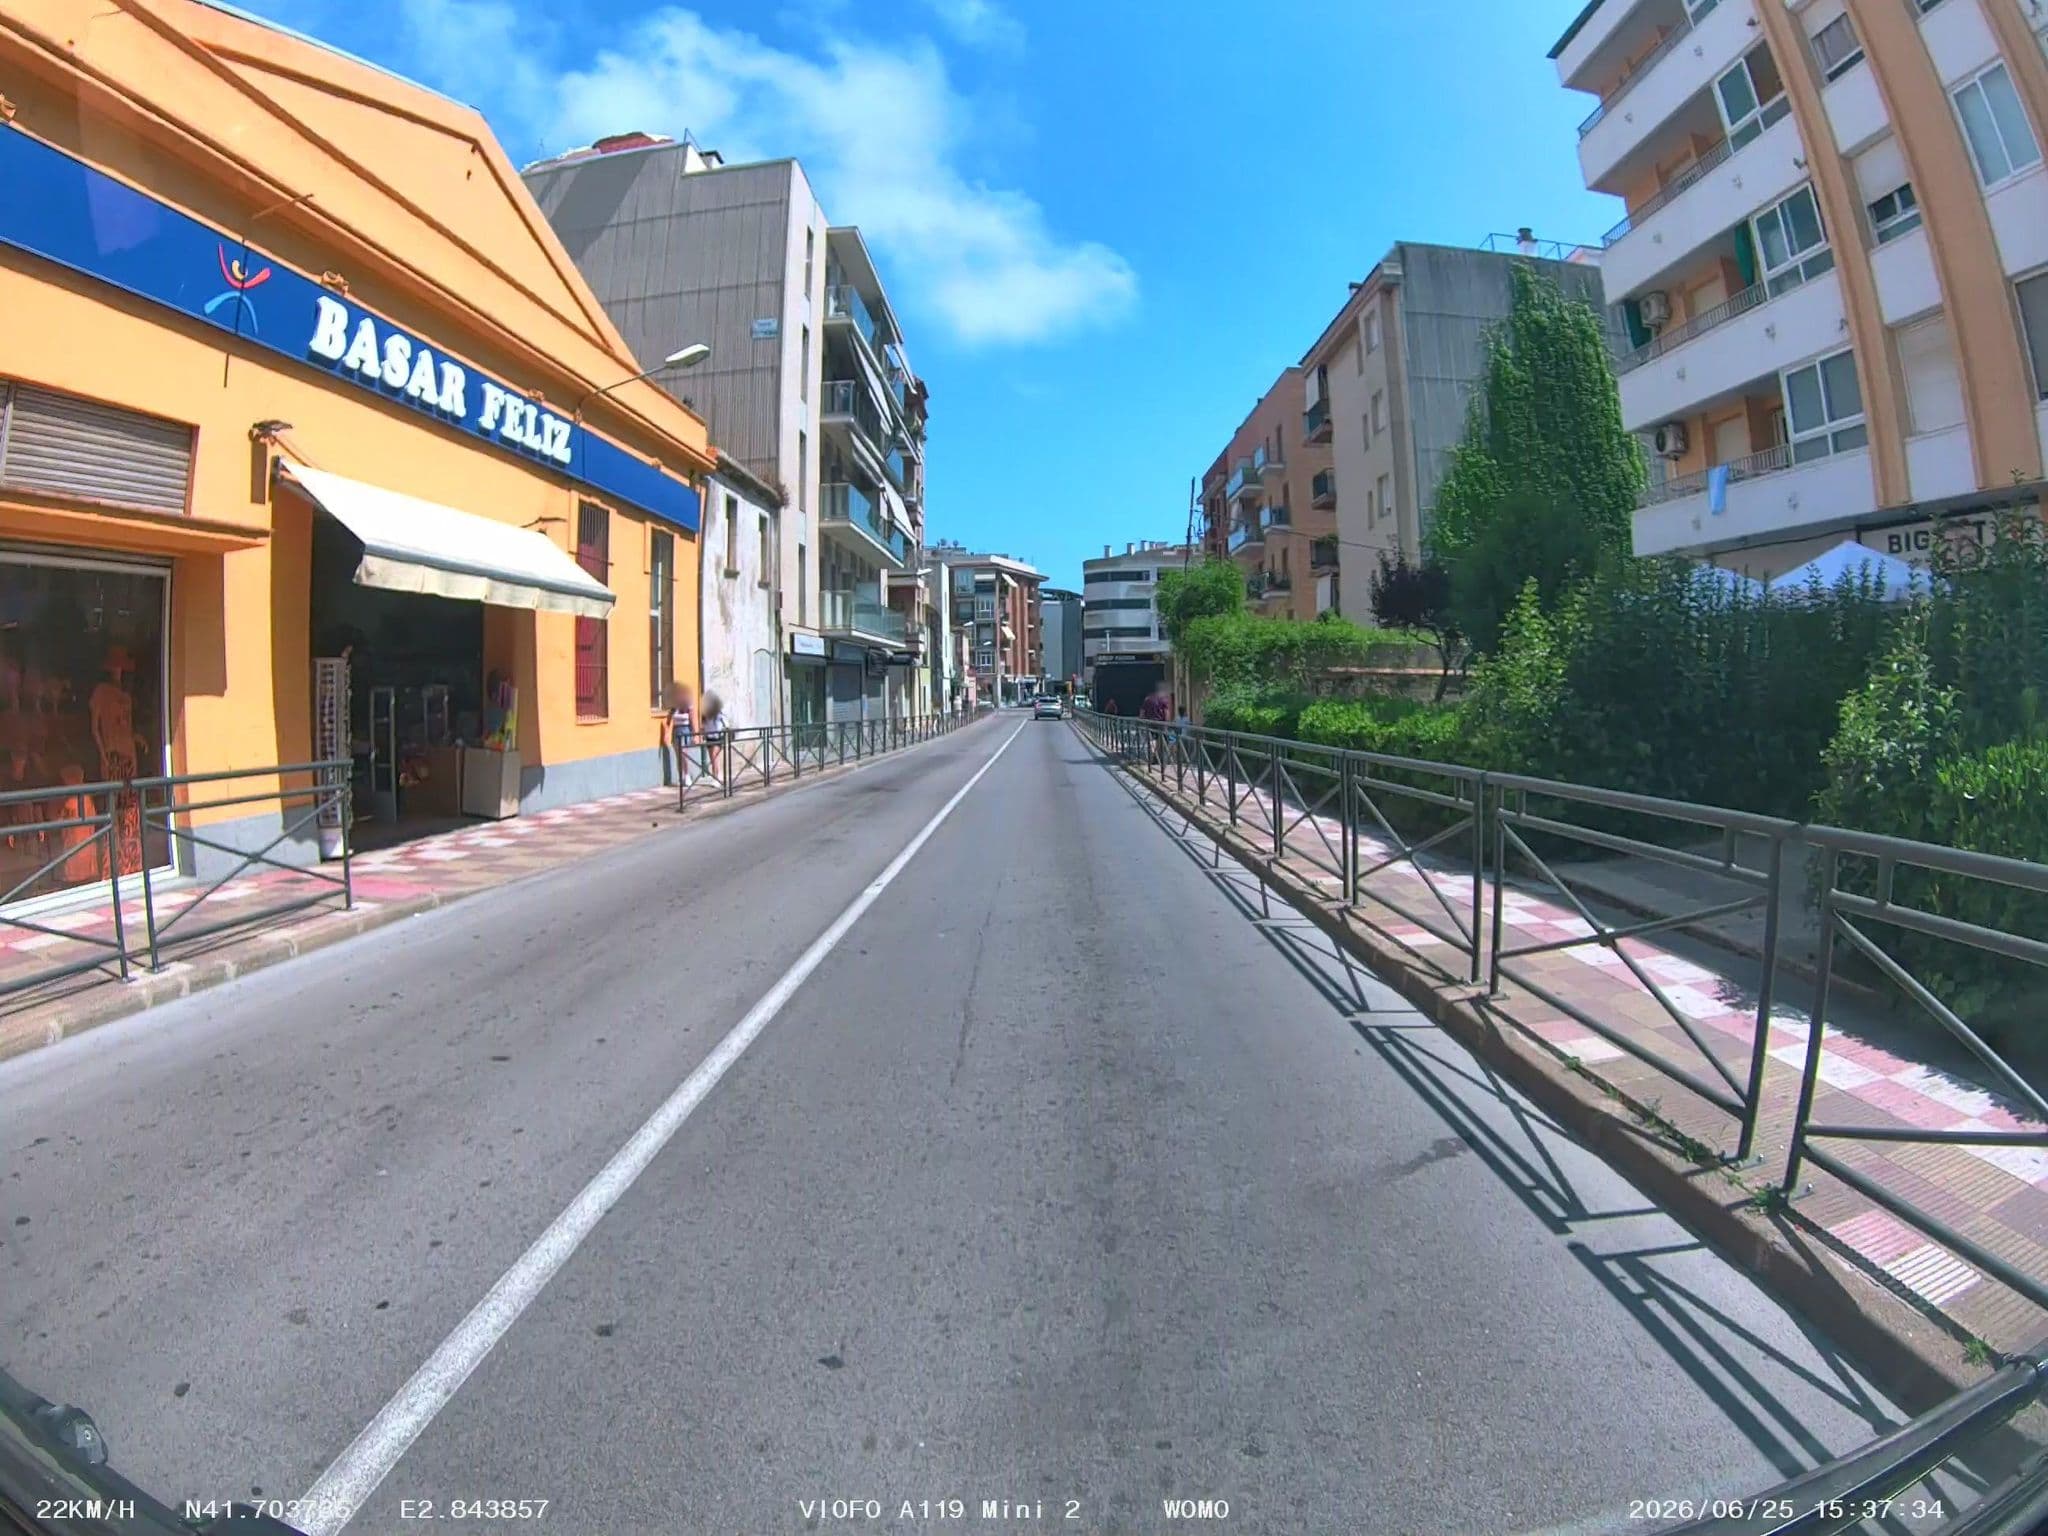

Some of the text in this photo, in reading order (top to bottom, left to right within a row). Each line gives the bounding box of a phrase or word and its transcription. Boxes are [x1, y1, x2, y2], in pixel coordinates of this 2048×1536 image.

[309, 296, 572, 465] BASAR FELIZ
[1887, 530, 1931, 554] BIG
